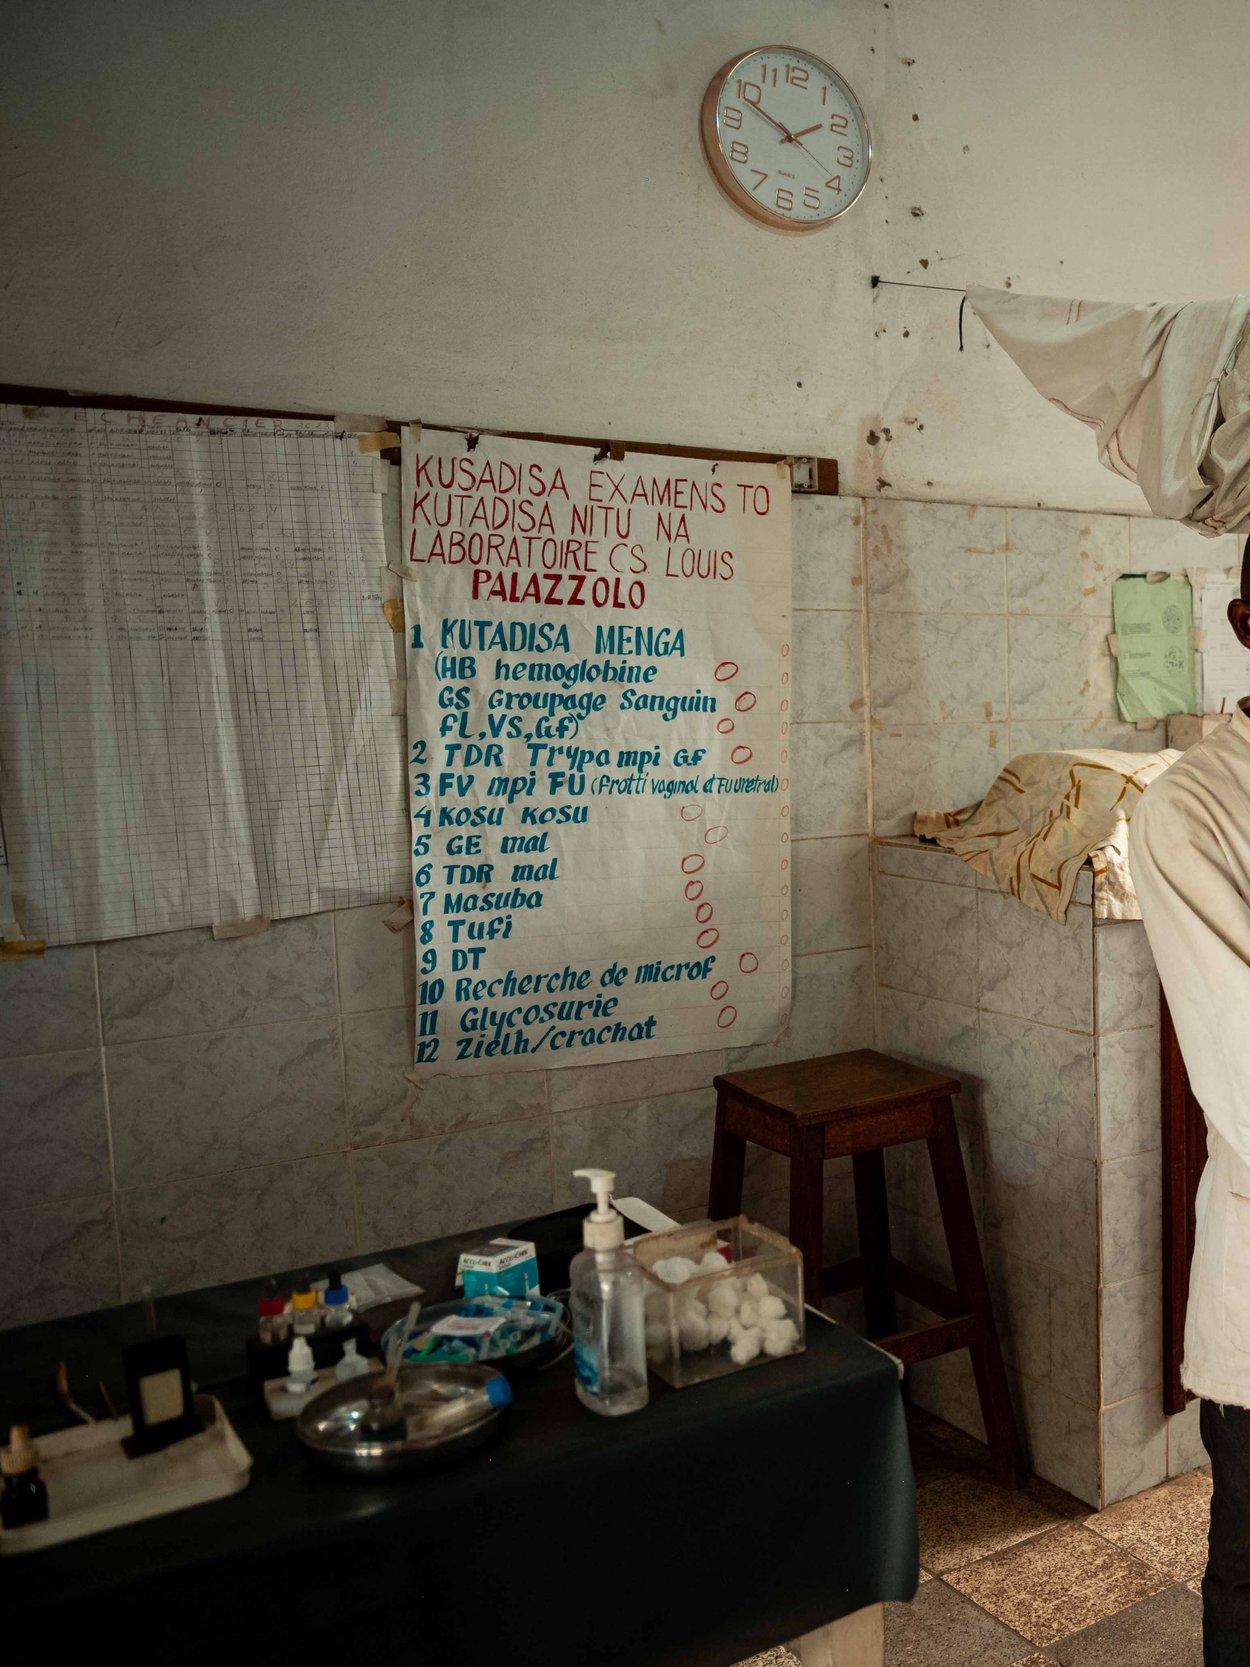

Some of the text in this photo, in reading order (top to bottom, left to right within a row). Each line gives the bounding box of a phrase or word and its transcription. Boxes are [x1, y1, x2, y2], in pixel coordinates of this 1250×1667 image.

[762, 64, 777, 87] 11
[785, 63, 809, 90] 12
[736, 79, 762, 105] 10
[822, 86, 827, 105] 1
[724, 106, 743, 130] 9
[830, 113, 849, 136] 2
[730, 141, 749, 164] 8
[836, 145, 854, 168] 3
[750, 169, 769, 191] 7
[825, 175, 842, 195] 4
[775, 188, 794, 211] 6
[803, 186, 821, 210] 5
[414, 453, 769, 516] KUSADISA EXAMENS TO
[412, 491, 690, 544] KUTADISA NITU NA
[409, 530, 734, 580] LABORATOIRE CS LOUIS
[472, 569, 646, 609] PALAZZOLO
[411, 618, 685, 657] 1 KUTADISA MENGA
[495, 658, 657, 688] hemoglobine
[438, 686, 716, 721] GS Groupage Sanguin
[410, 741, 426, 765] 2
[445, 743, 504, 767] TDR
[618, 745, 660, 775] mpi
[414, 773, 431, 796] 3
[439, 772, 475, 796] FV
[487, 770, 535, 803] mpi
[548, 772, 585, 796] FU
[717, 778, 733, 794] FU
[414, 806, 432, 827] 4
[413, 832, 551, 857] 5 GE mal
[415, 858, 560, 888] 6 TDR mal
[419, 888, 543, 916] 7 Masuba
[420, 919, 434, 945] 8
[420, 947, 487, 974] 9 DT
[418, 978, 445, 1005] 10
[456, 964, 592, 1002] Recherche
[600, 962, 628, 987] de
[418, 994, 619, 1043] 11 Glycosurie
[416, 1038, 439, 1063] 12
